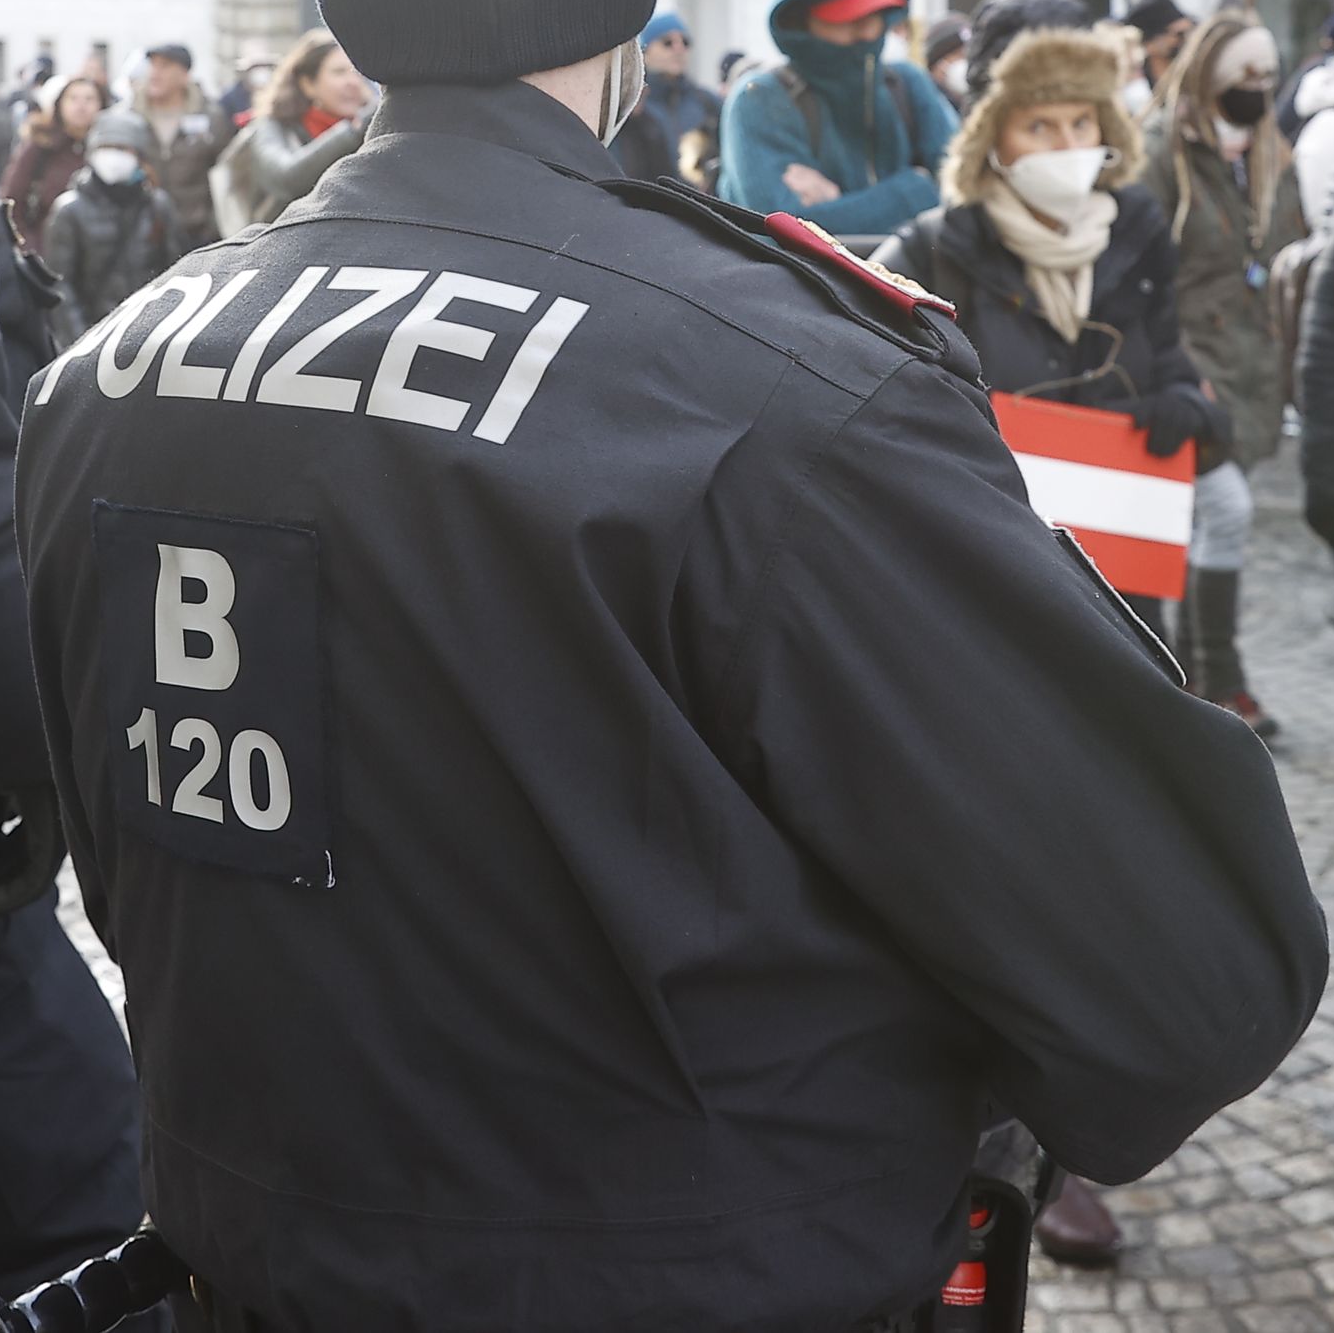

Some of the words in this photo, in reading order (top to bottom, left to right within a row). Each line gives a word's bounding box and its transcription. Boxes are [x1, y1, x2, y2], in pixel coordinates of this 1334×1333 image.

[34, 265, 590, 445] POLIZEI
[154, 543, 241, 691] B
[126, 707, 293, 832] 120
